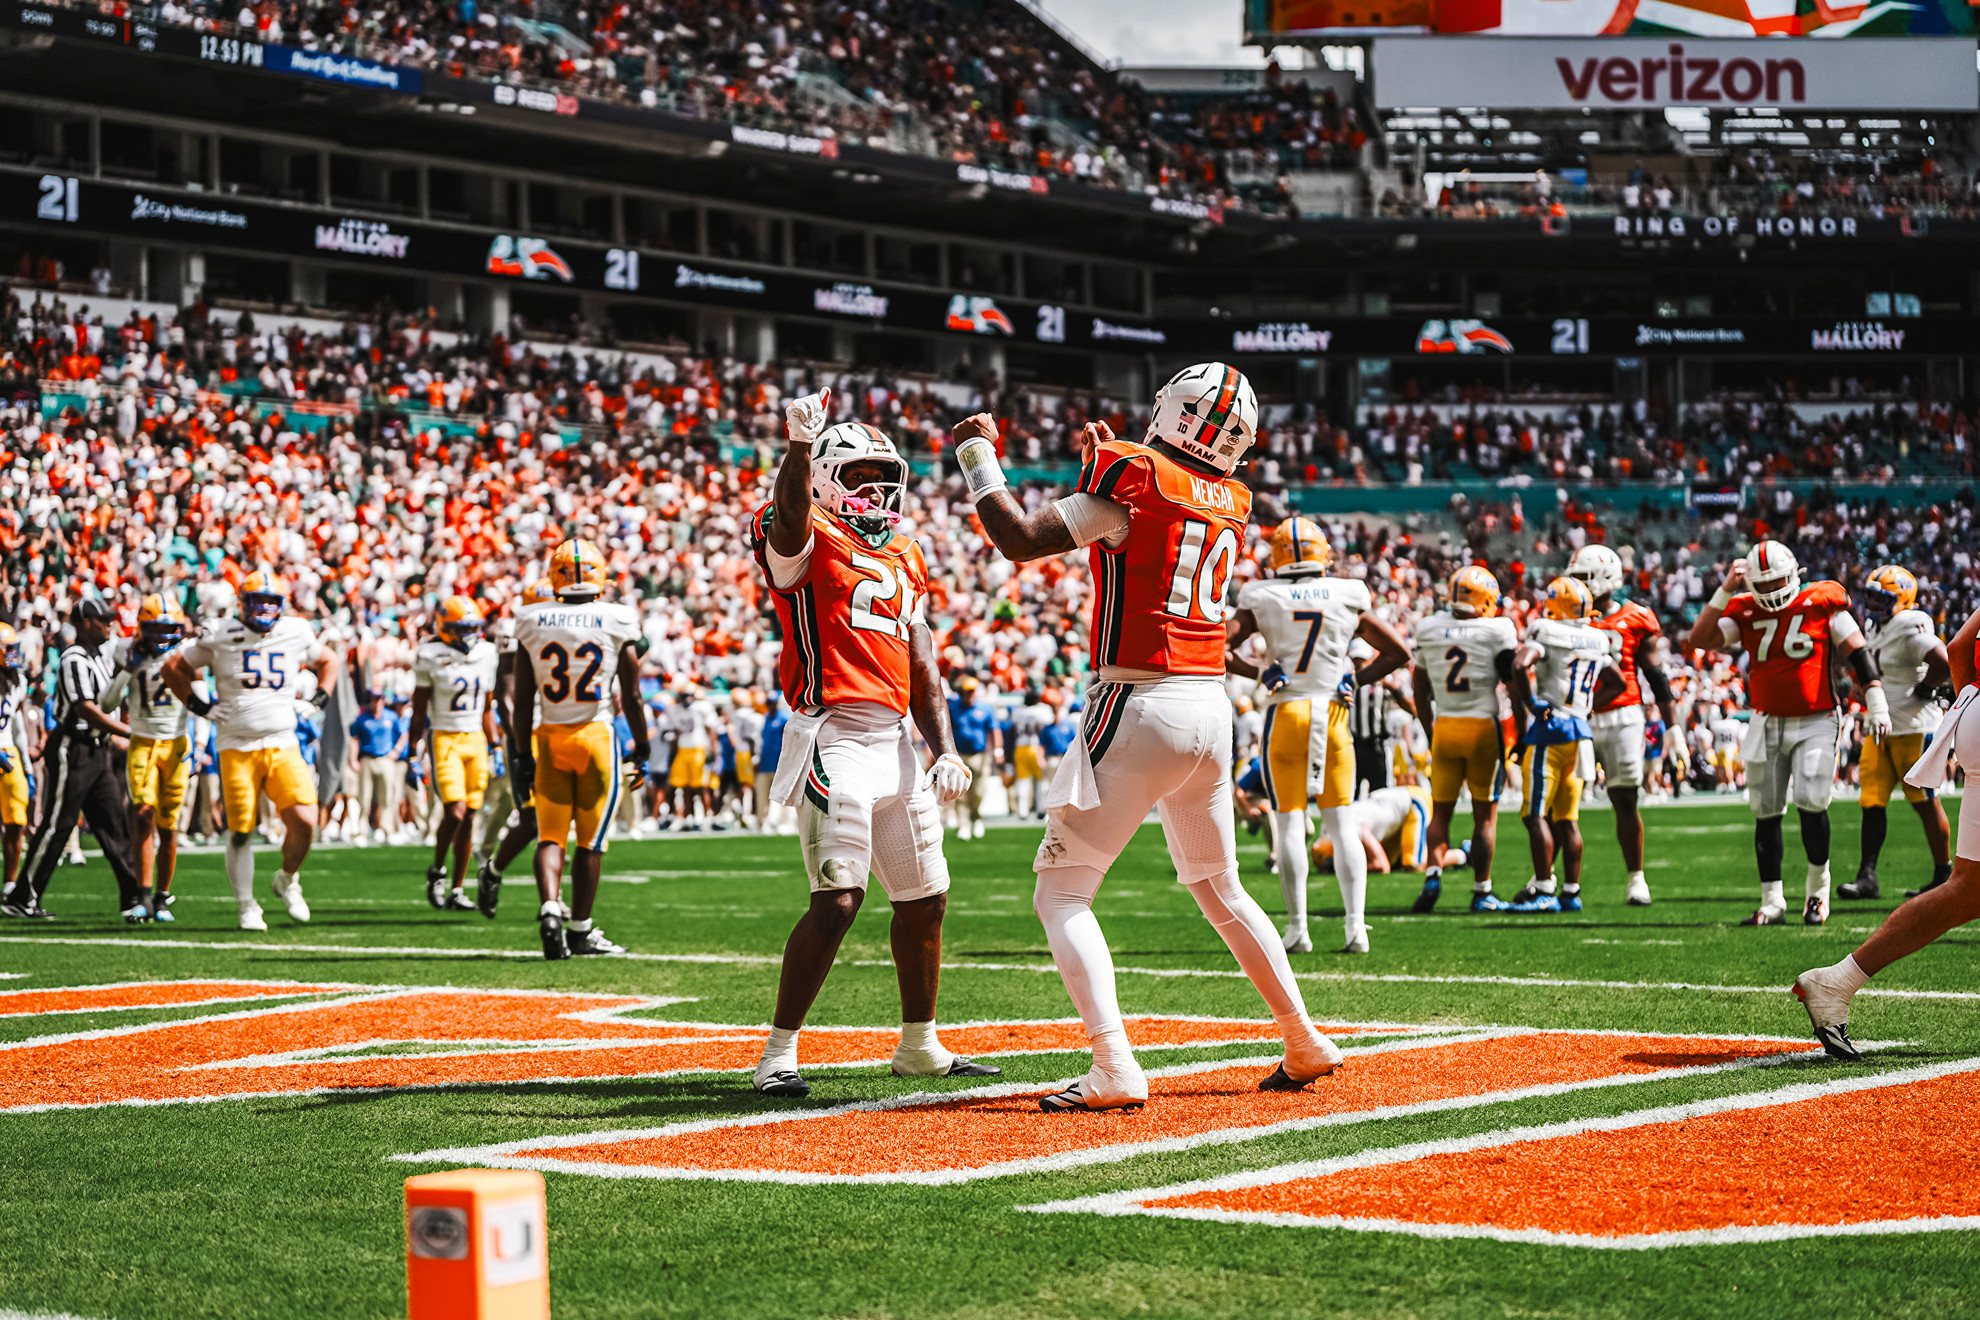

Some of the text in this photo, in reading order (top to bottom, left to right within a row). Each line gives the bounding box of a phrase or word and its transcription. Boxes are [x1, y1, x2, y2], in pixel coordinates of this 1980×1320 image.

[1555, 43, 1806, 102] verizon
[37, 174, 80, 223] 21
[315, 225, 410, 259] MALLORY
[1614, 215, 1858, 237] RING OF HONOR
[604, 248, 640, 291] 21
[1036, 304, 1065, 343] 21
[1233, 330, 1331, 352] MALLORY
[1551, 318, 1590, 354] 21
[1811, 329, 1906, 350] MALLORY
[1177, 422, 1188, 434] 10
[1181, 439, 1217, 462] MIAMI
[1164, 518, 1237, 623] 10
[1289, 588, 1330, 601] WARD
[537, 612, 603, 628] MARCELIN
[1752, 614, 1814, 662] 76
[1293, 610, 1324, 674] 7
[242, 649, 286, 691] 55
[540, 641, 603, 704] 32
[1444, 645, 1471, 693] 2
[1564, 654, 1596, 708] 14
[450, 676, 480, 712] 21
[494, 1220, 531, 1263] U
